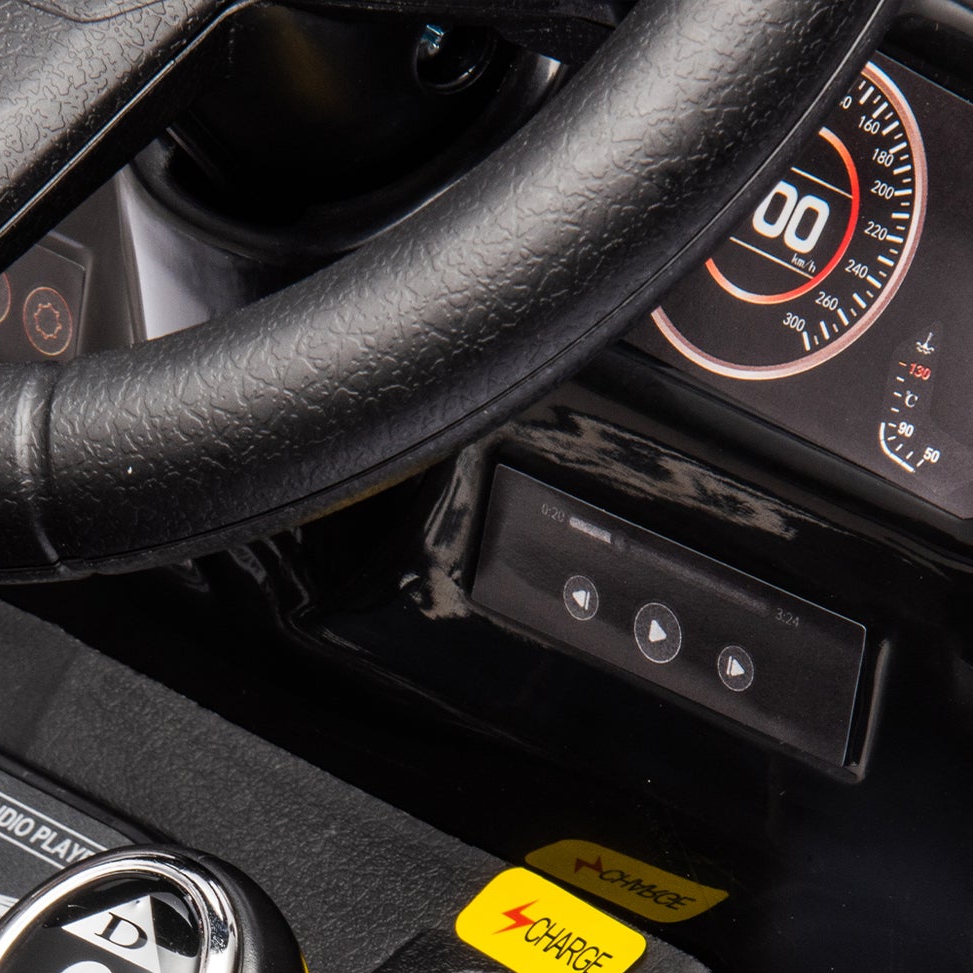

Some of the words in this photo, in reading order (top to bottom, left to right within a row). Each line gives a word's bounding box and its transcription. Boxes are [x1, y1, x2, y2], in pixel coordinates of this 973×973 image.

[858, 115, 880, 135] 160
[872, 148, 894, 167] 180
[870, 180, 894, 200] 200
[752, 180, 830, 254] 00
[864, 221, 888, 241] 220
[791, 253, 817, 273] km/h
[845, 259, 868, 279] 240
[815, 291, 839, 311] 260
[783, 312, 805, 332] 300
[909, 363, 931, 381] 130
[897, 421, 915, 438] 90
[923, 447, 941, 464] 50
[94, 911, 148, 950] D
